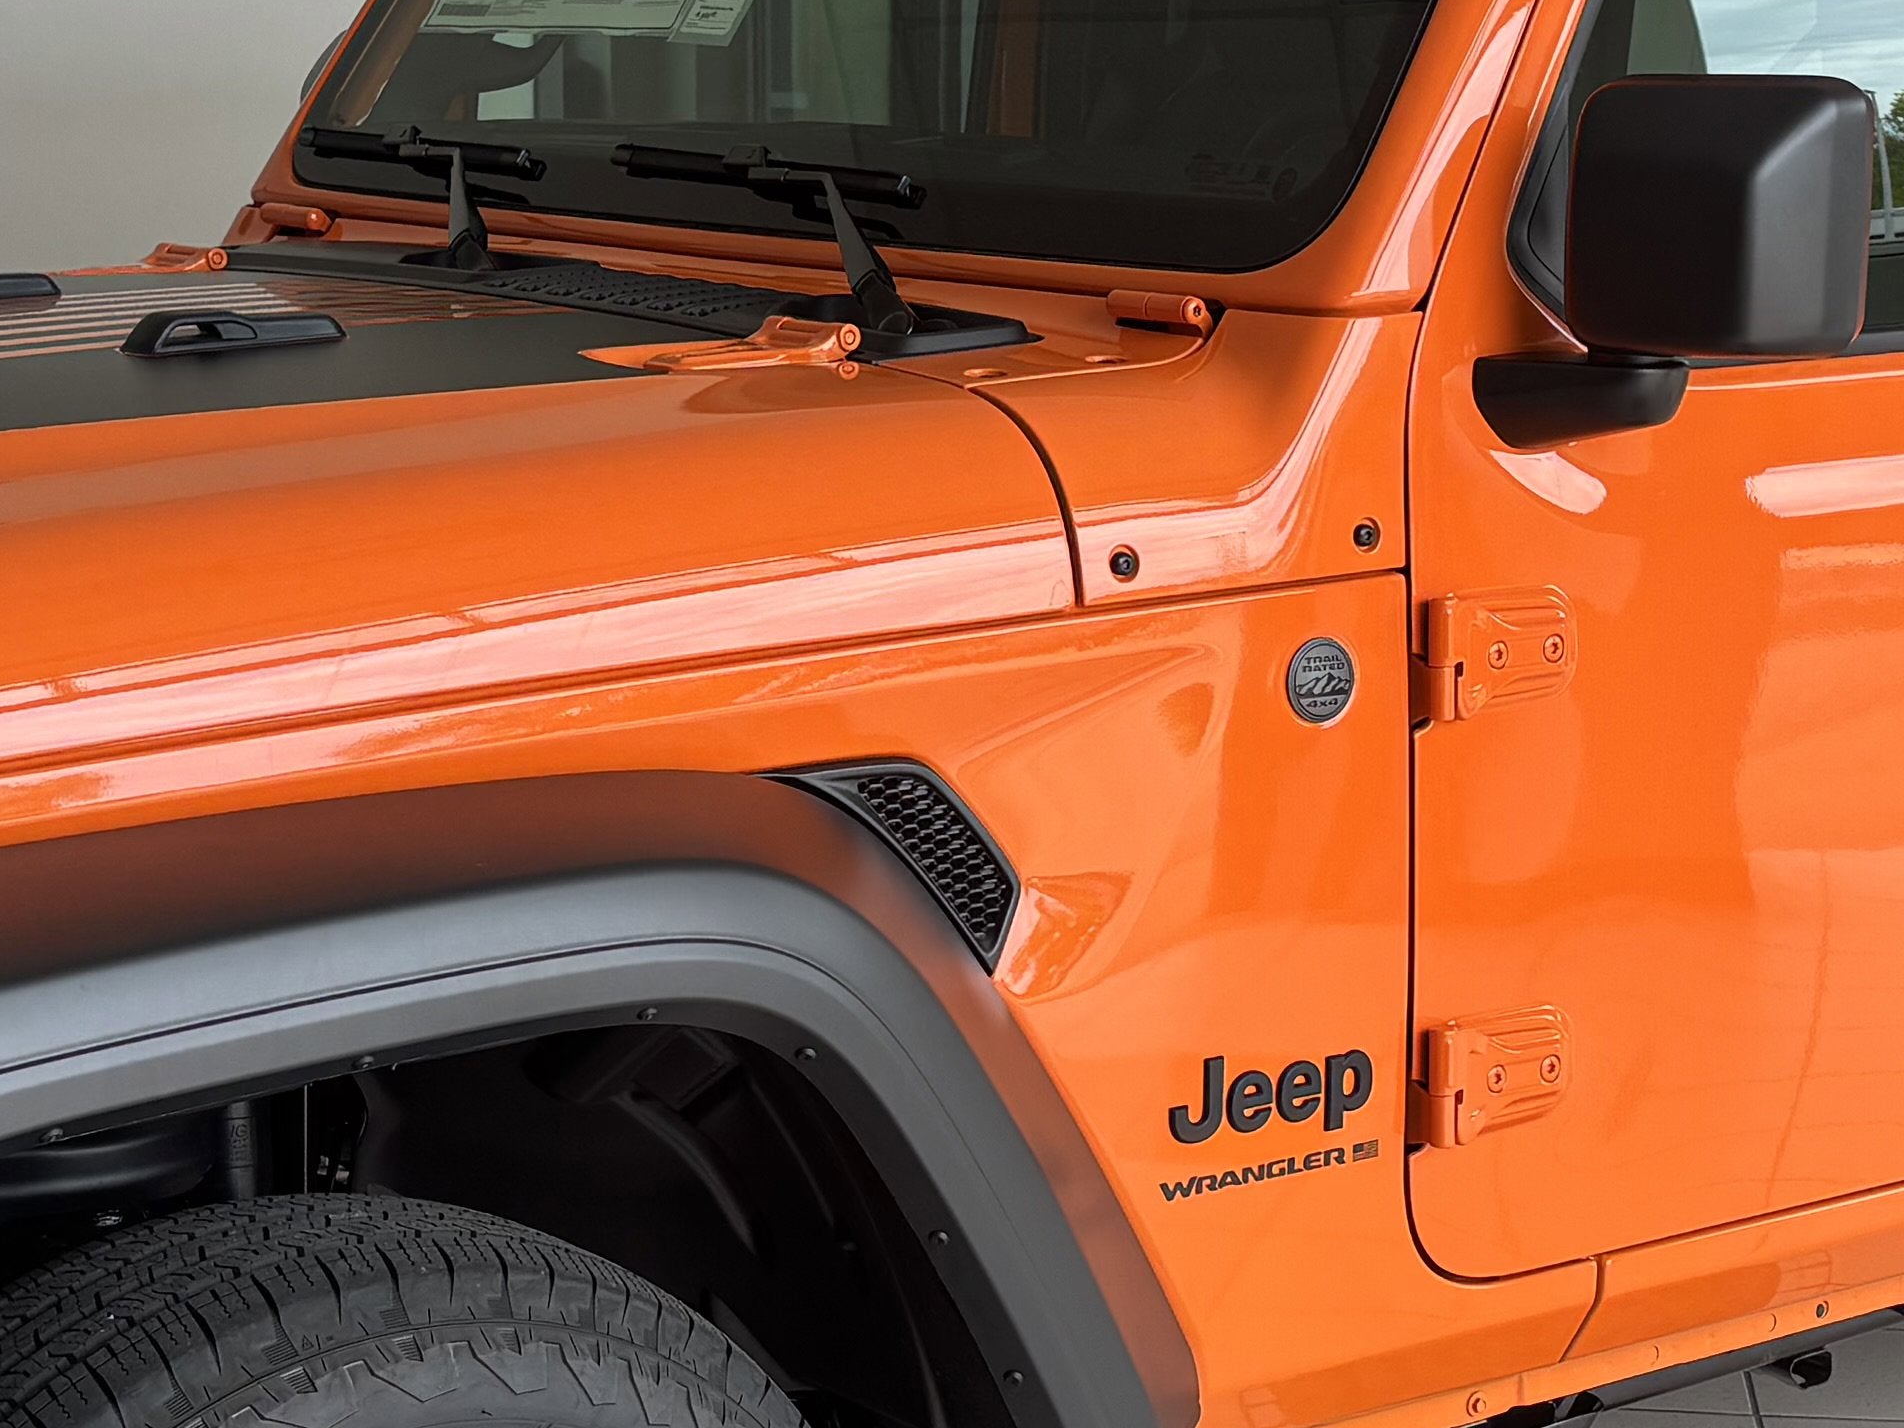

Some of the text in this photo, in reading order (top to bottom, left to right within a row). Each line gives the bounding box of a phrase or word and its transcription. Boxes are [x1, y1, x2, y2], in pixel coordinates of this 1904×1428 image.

[1302, 663, 1345, 673] RATED
[1304, 655, 1342, 664] TRAIL
[1168, 1049, 1373, 1144] Jeep
[1159, 1147, 1346, 1201] WRANGLER
